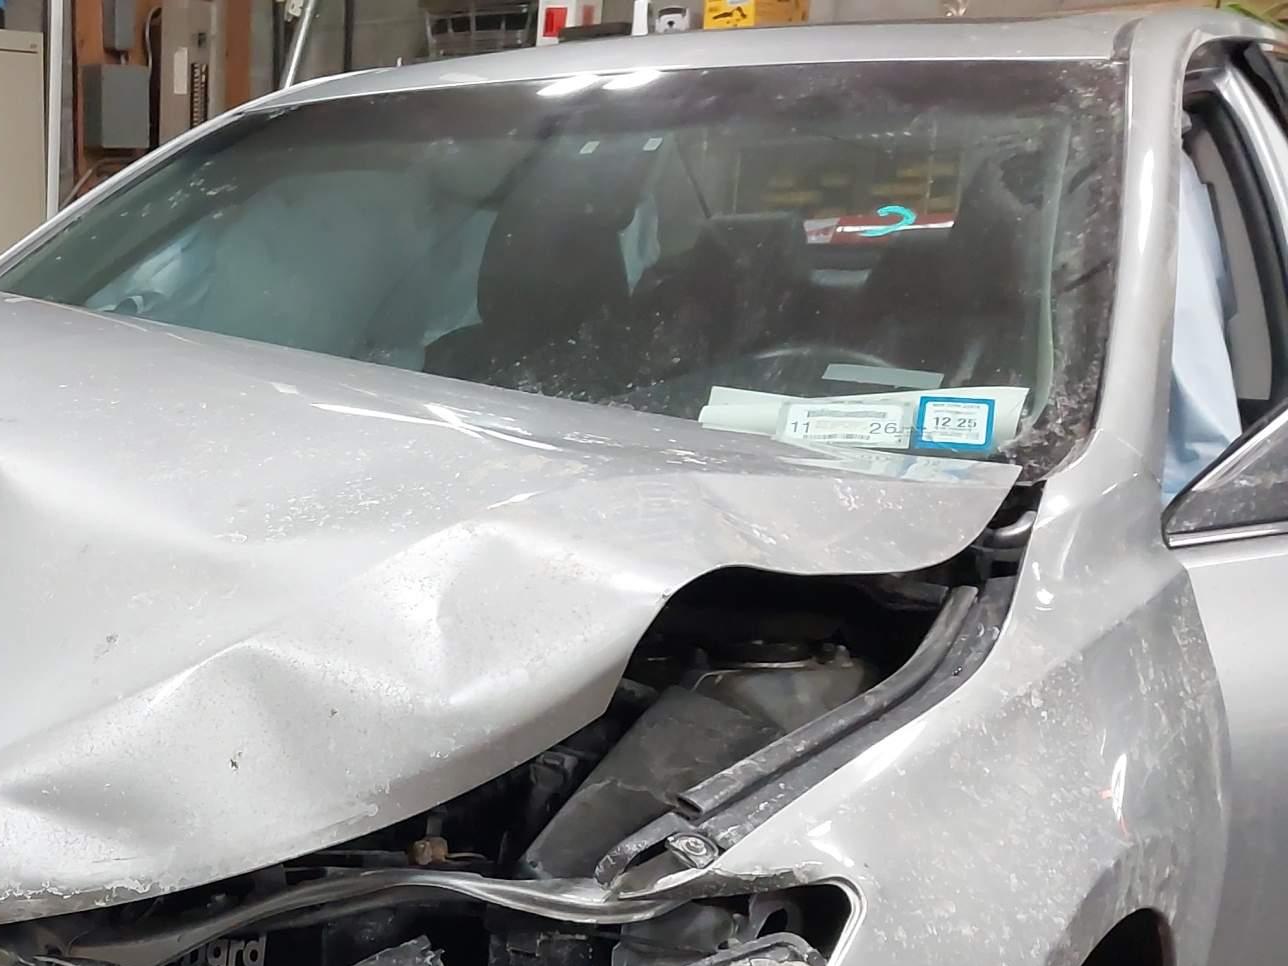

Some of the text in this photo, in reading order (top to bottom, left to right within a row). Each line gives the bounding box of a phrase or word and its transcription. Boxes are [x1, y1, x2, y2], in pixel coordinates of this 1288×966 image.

[791, 421, 898, 435] 11 26
[933, 416, 977, 428] 12 25
